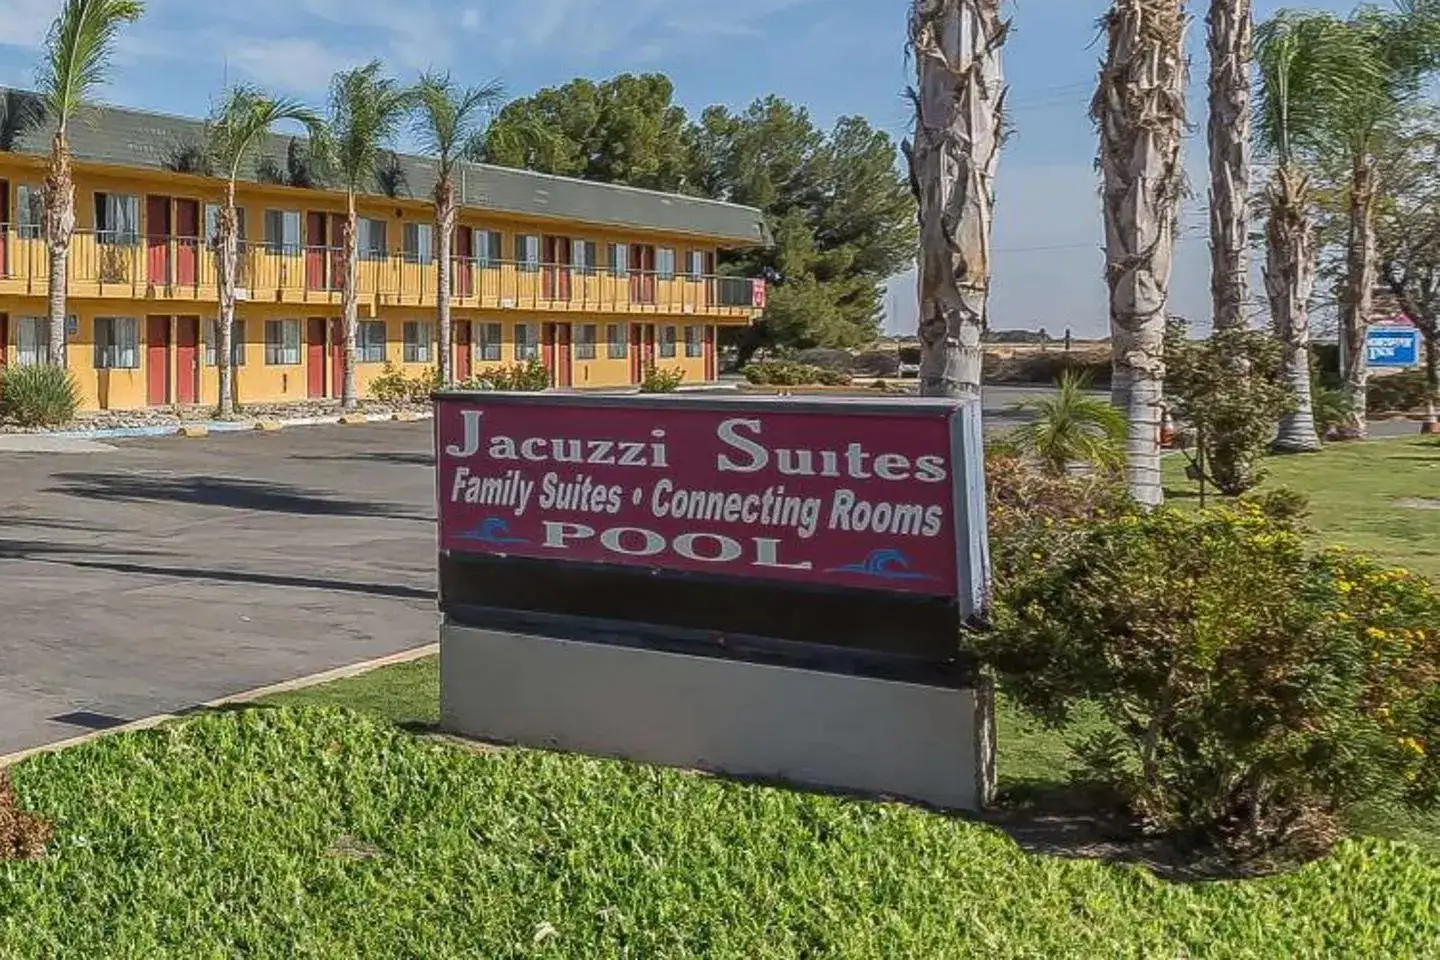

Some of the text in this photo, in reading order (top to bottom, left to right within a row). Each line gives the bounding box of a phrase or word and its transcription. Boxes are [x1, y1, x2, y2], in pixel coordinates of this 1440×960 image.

[446, 409, 947, 483] Jacuzzi Suites
[450, 467, 944, 538] Family Suites Connecting Rooms
[541, 520, 814, 571] POOL
